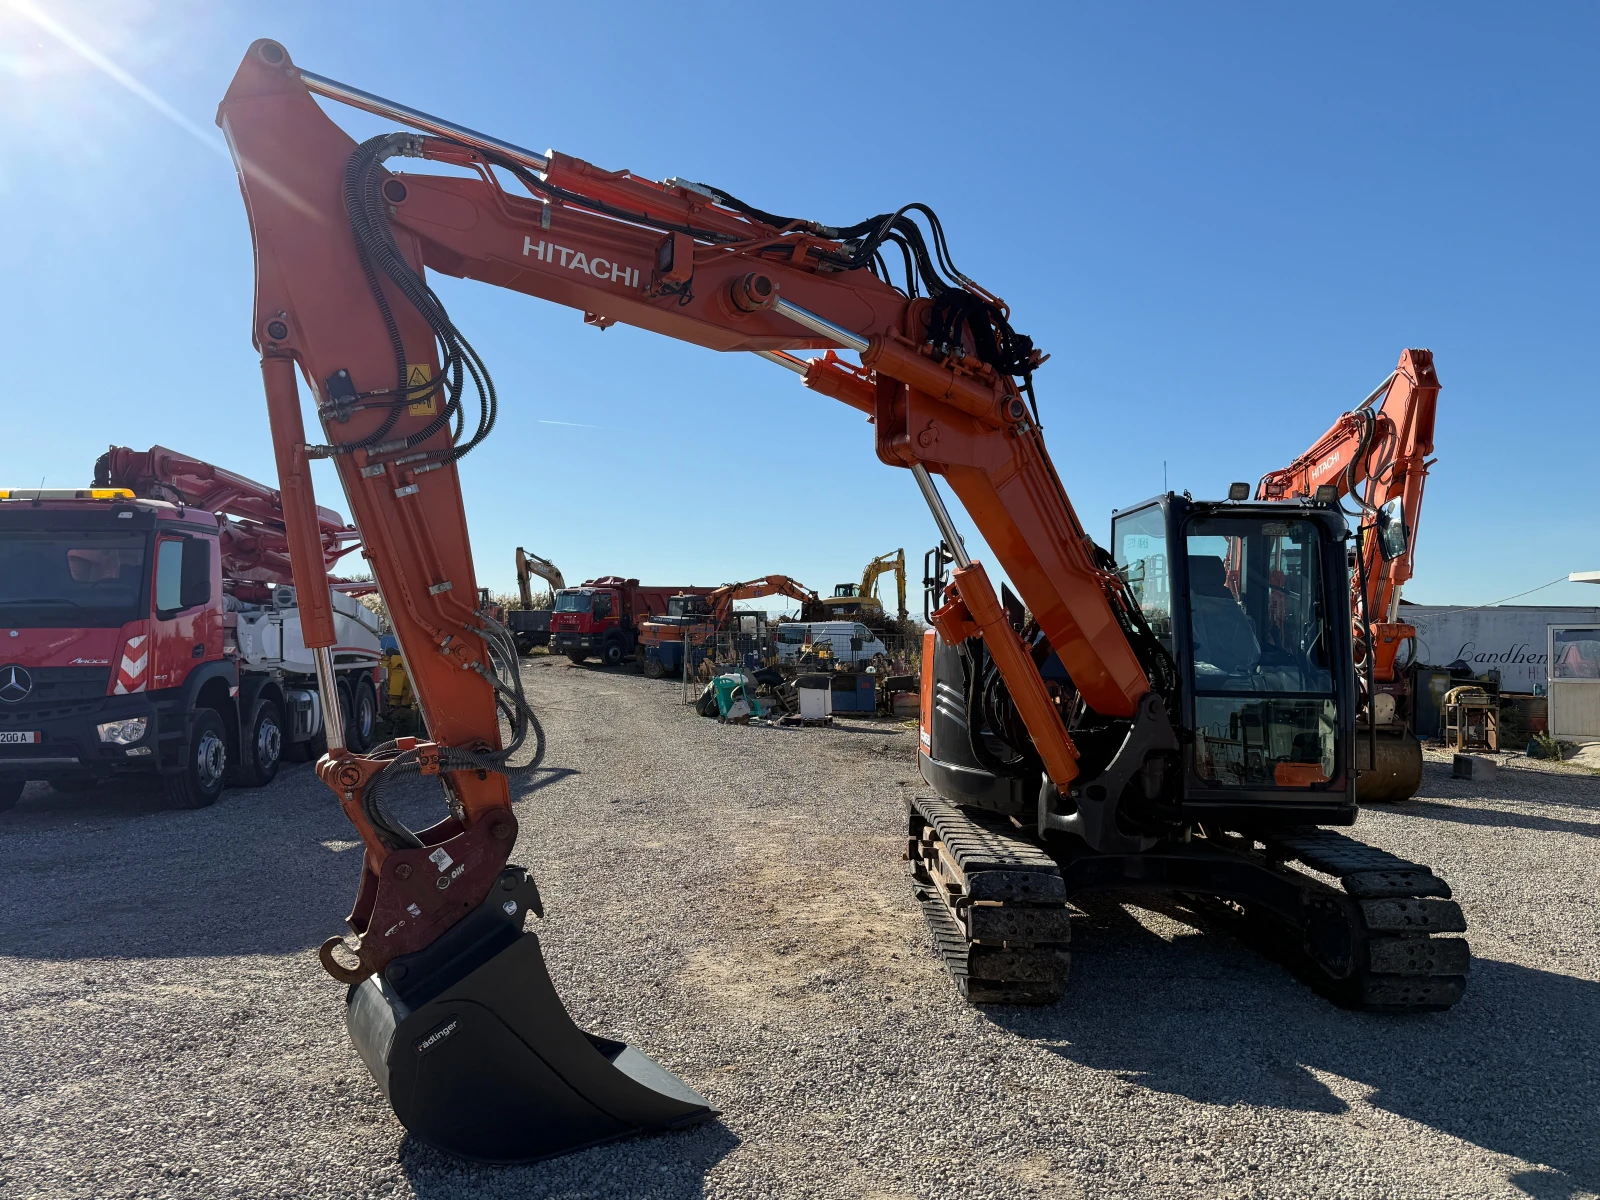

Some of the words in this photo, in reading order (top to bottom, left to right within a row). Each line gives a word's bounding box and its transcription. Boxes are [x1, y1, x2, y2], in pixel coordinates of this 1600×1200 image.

[523, 236, 639, 288] HITACHI
[1311, 450, 1340, 480] HITACHI
[0, 732, 19, 743] 200
[20, 733, 27, 743] A
[418, 1020, 457, 1051] rädlinger
